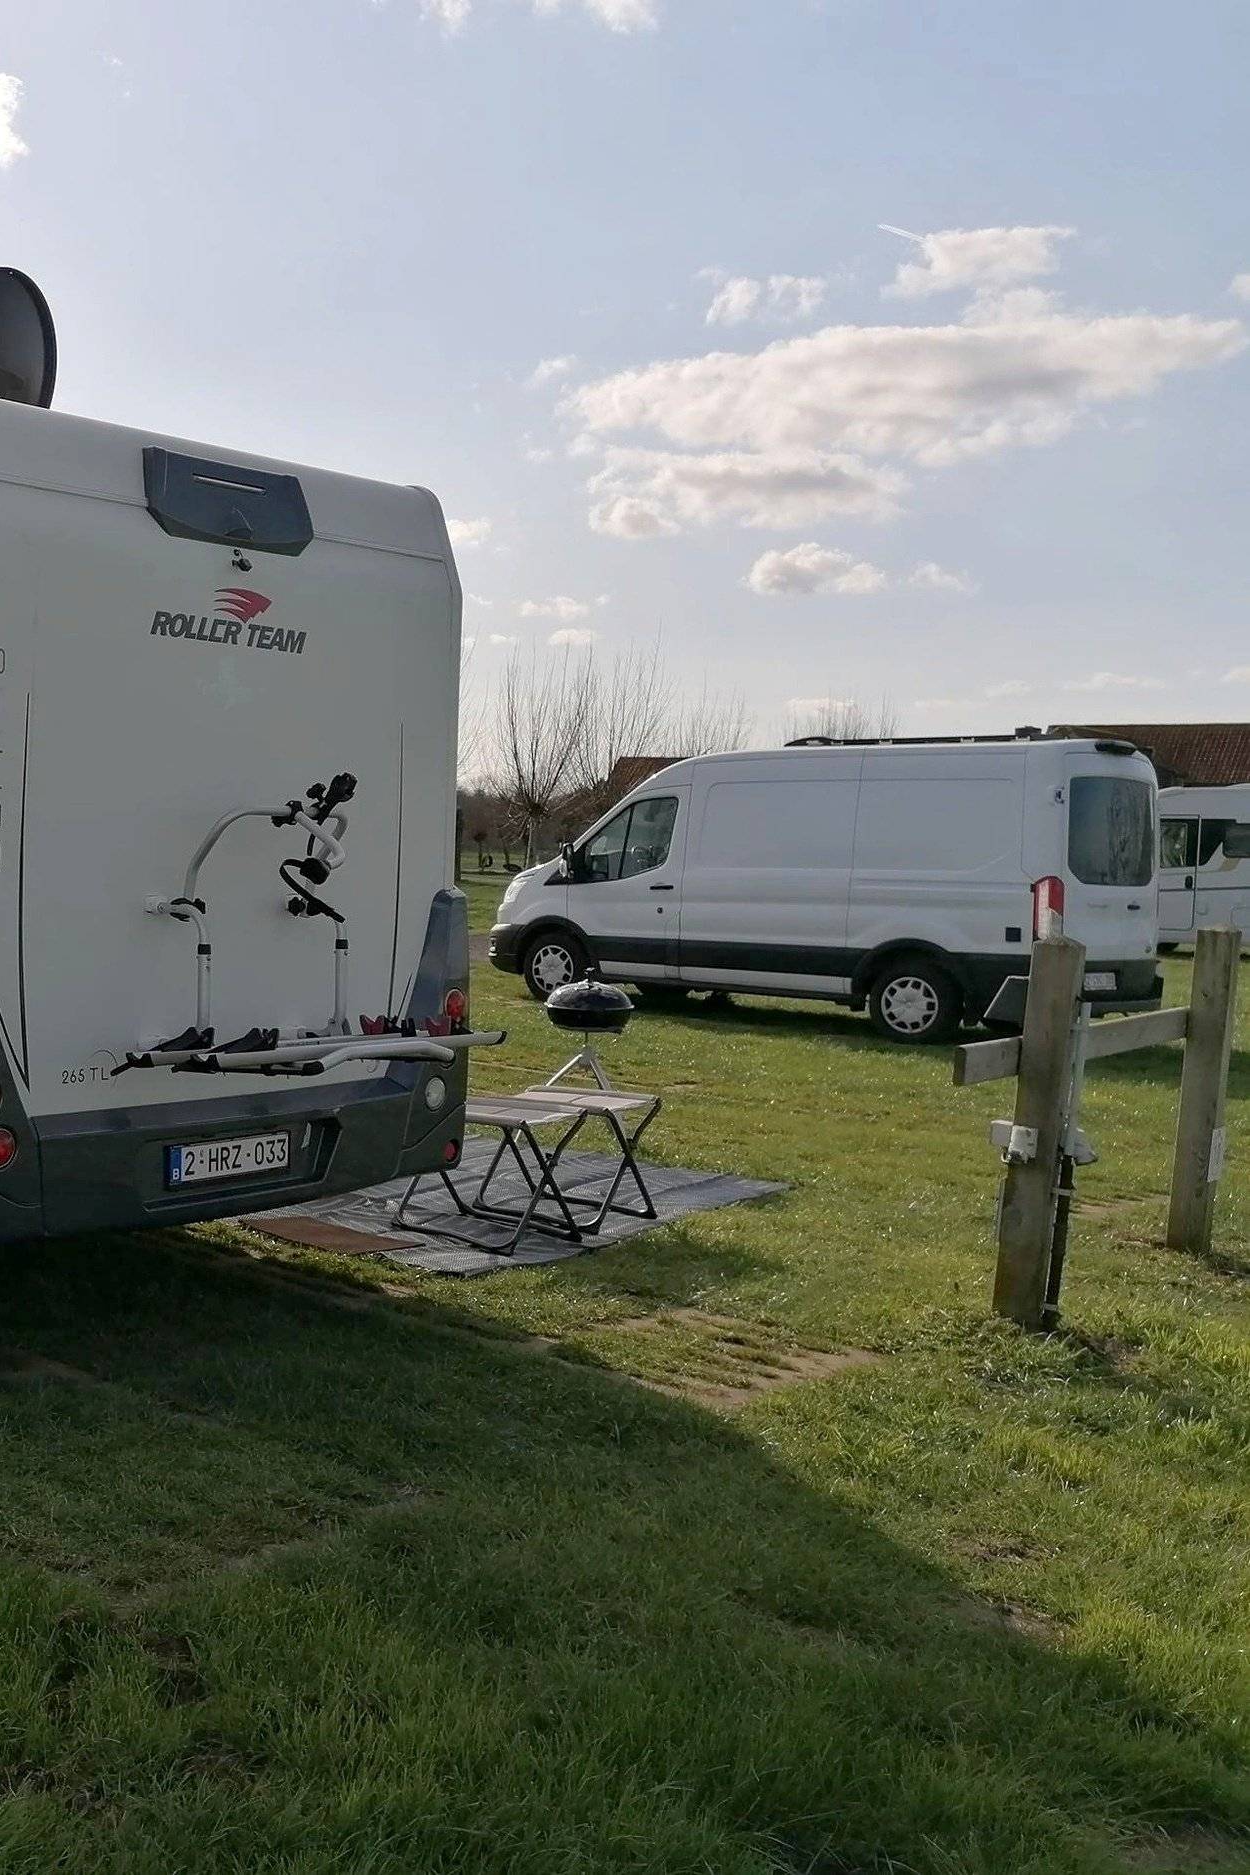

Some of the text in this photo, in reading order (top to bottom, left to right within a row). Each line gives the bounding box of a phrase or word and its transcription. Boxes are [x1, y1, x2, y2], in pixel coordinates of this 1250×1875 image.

[150, 611, 307, 654] ROLLER TEAM
[61, 1067, 109, 1084] 265 TL
[172, 1168, 180, 1180] B
